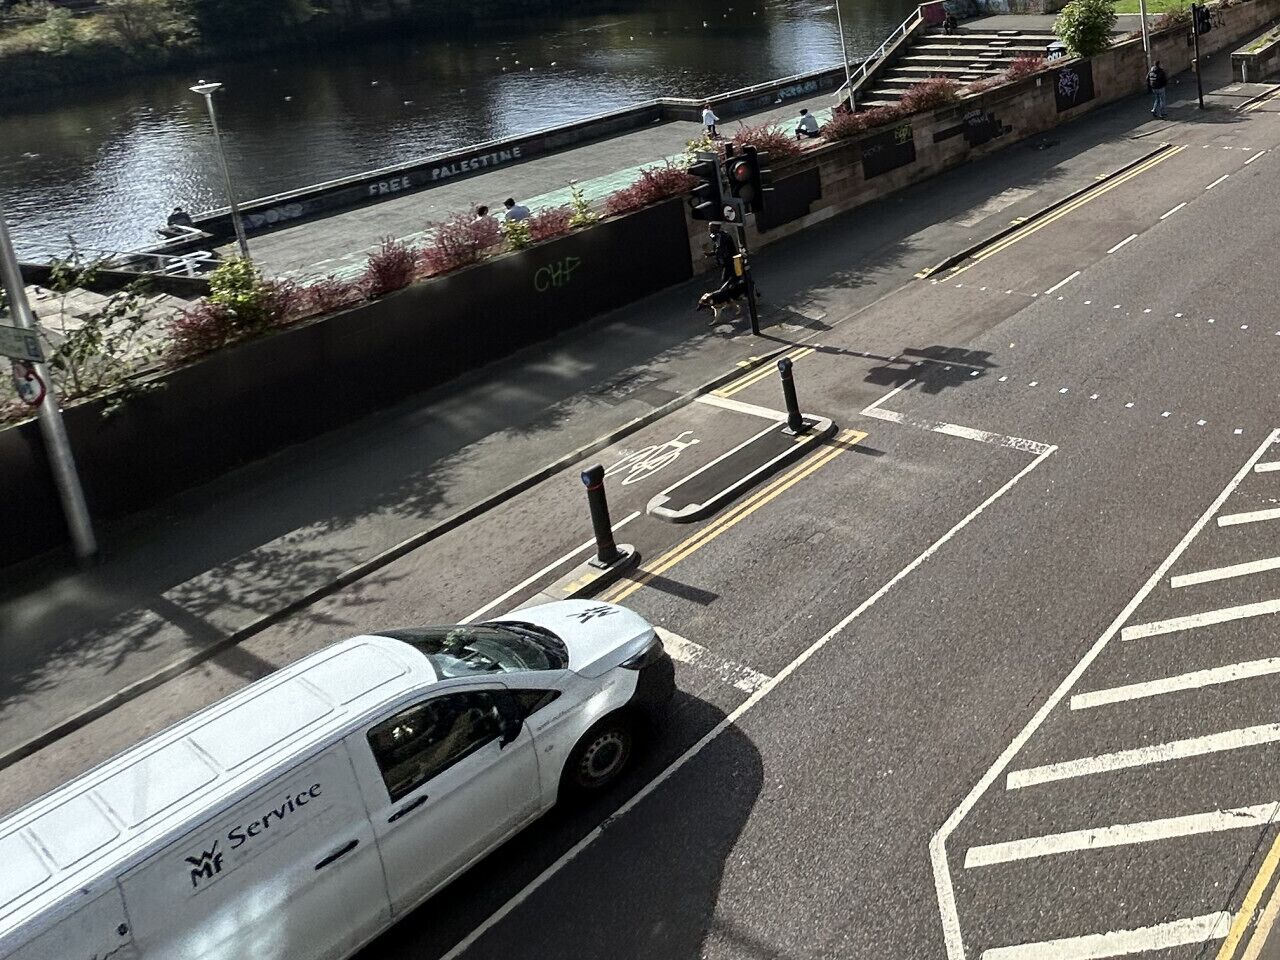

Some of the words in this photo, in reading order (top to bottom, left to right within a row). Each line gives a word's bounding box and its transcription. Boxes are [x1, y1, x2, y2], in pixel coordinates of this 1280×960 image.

[369, 175, 412, 196] FREE
[431, 147, 522, 181] PALESTINE
[228, 783, 322, 850] Service
